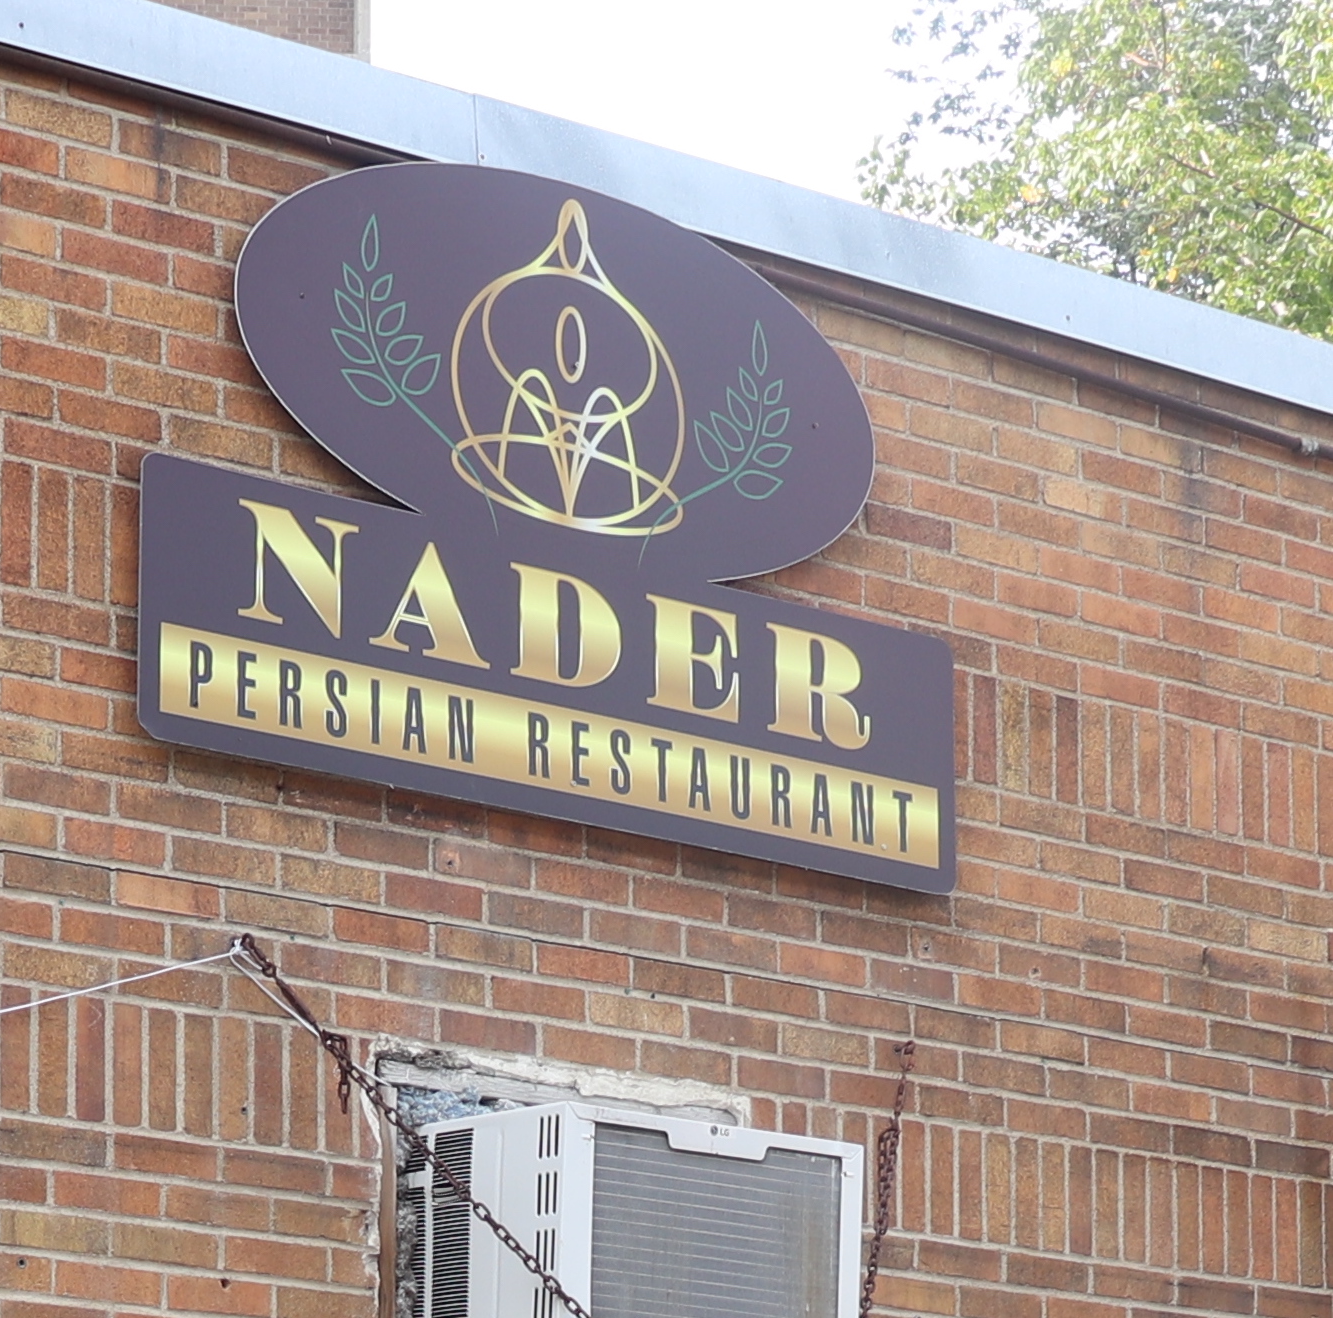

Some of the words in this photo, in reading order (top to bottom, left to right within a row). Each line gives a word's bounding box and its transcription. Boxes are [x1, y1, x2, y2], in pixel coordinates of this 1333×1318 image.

[237, 497, 871, 751] NADER
[189, 639, 476, 765] PERSIAN
[527, 711, 913, 854] RESTAURANT
[719, 1128, 730, 1137] LG
